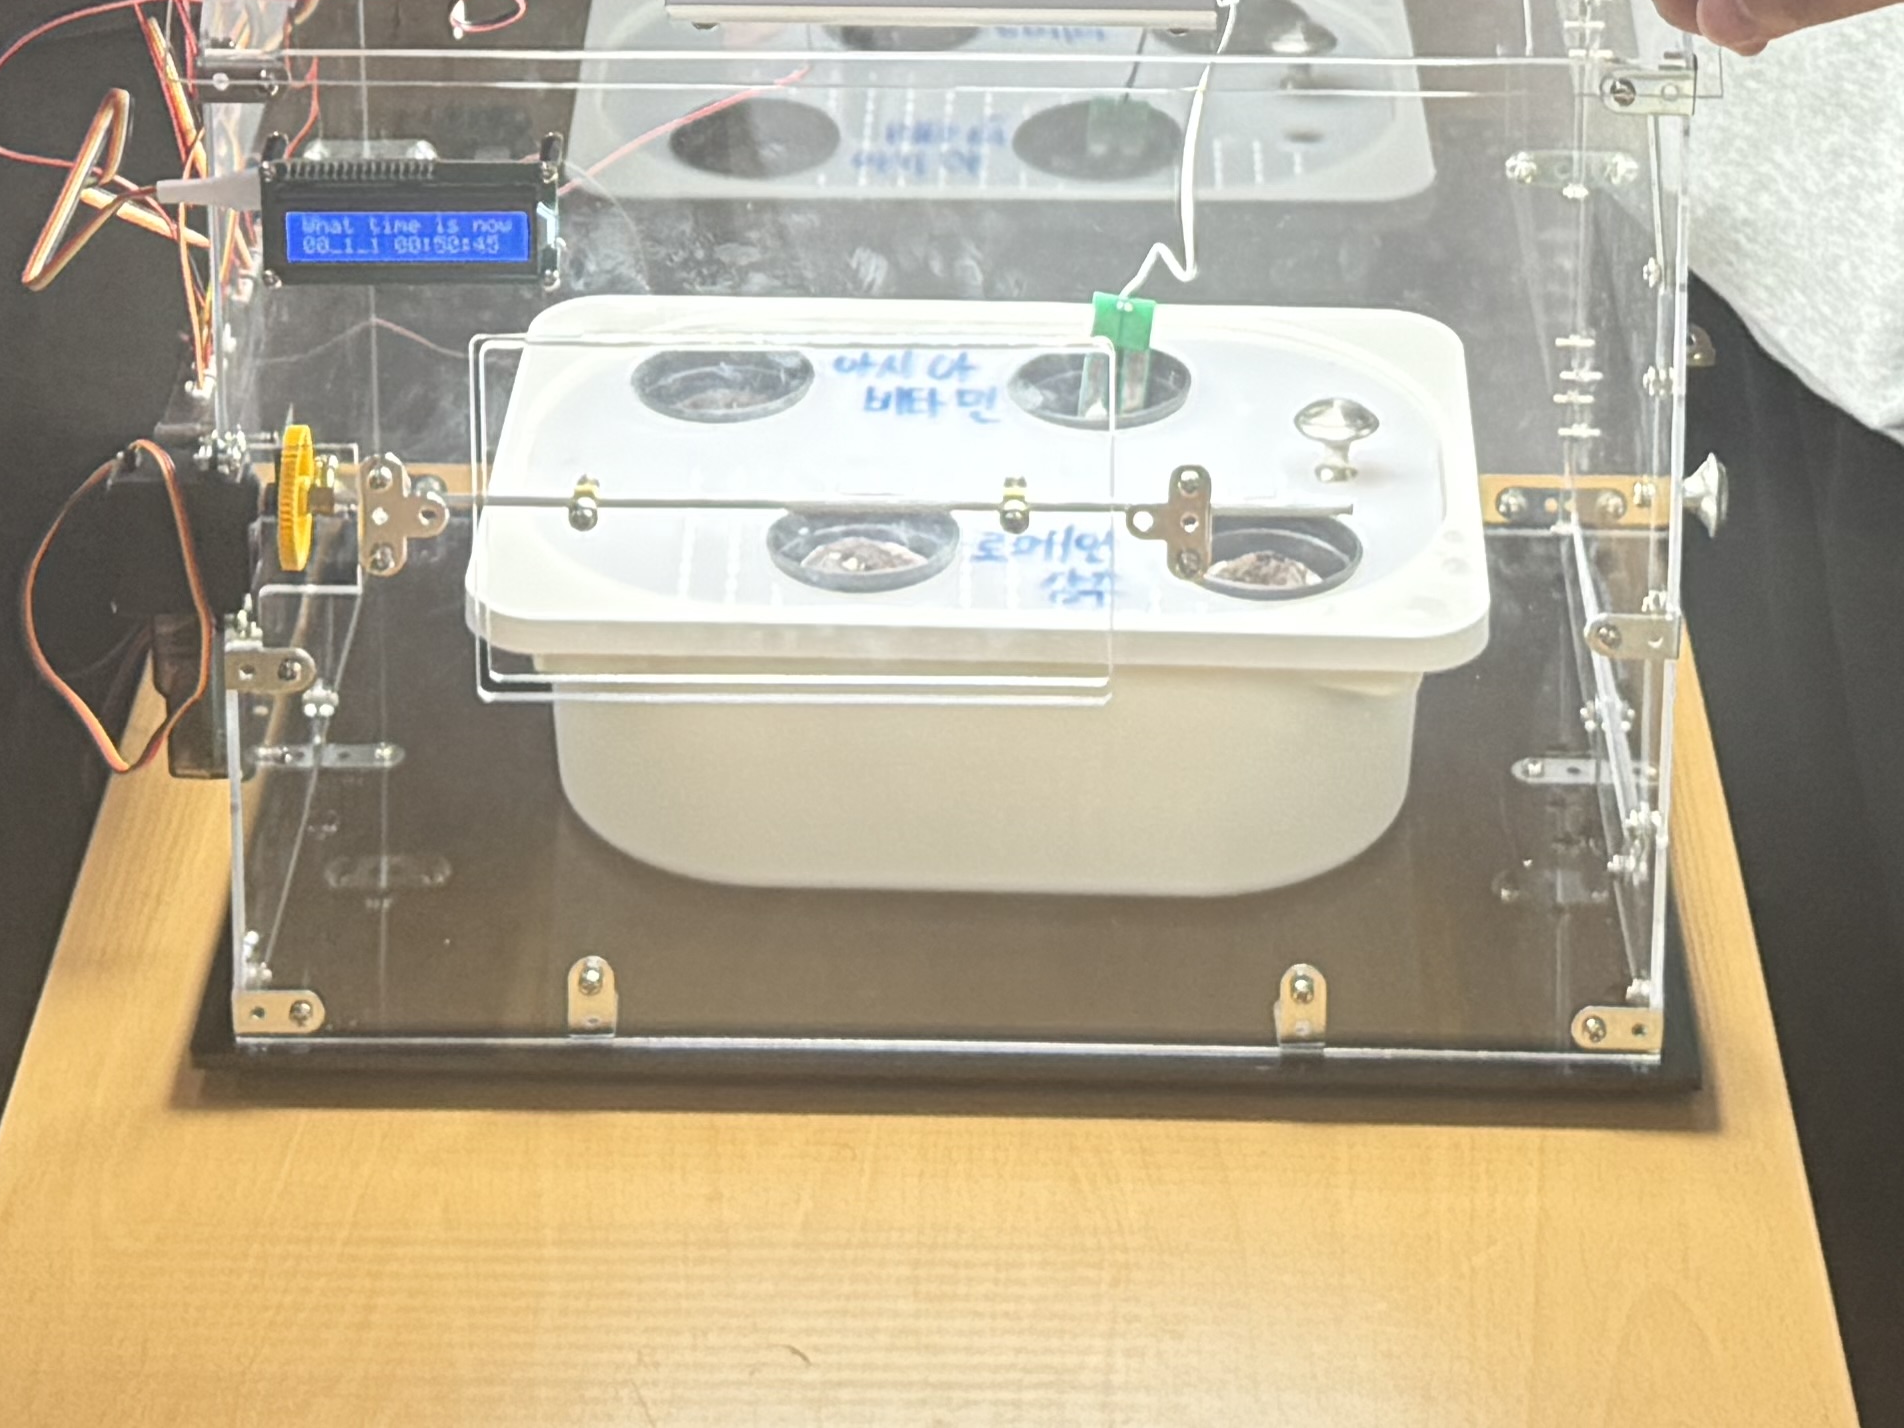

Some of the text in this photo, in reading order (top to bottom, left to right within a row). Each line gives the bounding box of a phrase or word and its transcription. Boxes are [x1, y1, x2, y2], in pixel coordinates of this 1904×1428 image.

[302, 215, 513, 235] What time is now
